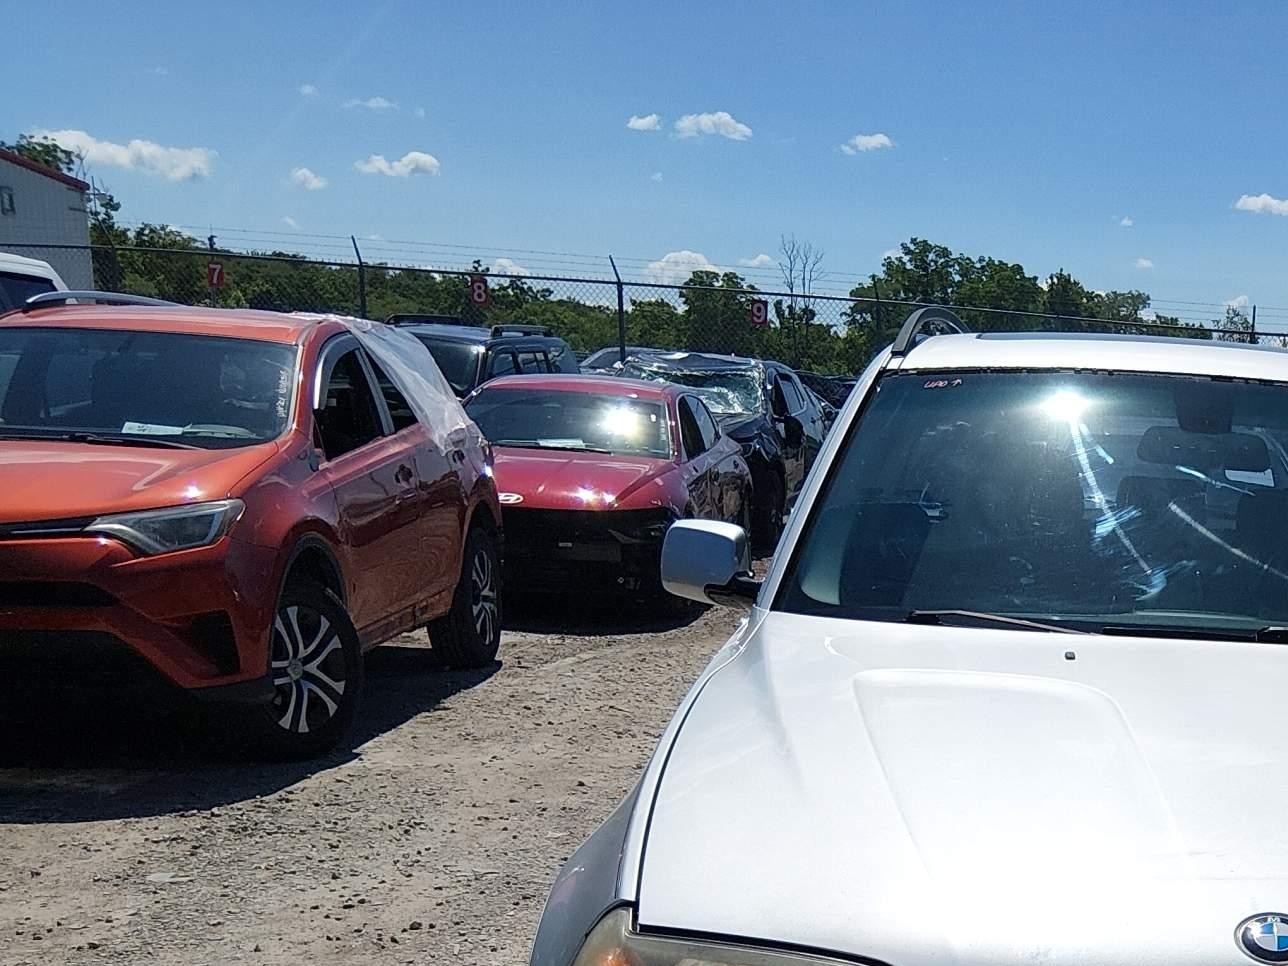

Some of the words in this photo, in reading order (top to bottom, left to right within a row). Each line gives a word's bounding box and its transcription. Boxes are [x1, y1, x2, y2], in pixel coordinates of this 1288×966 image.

[209, 264, 221, 284] 7
[474, 282, 486, 302] 8
[753, 303, 765, 323] 9
